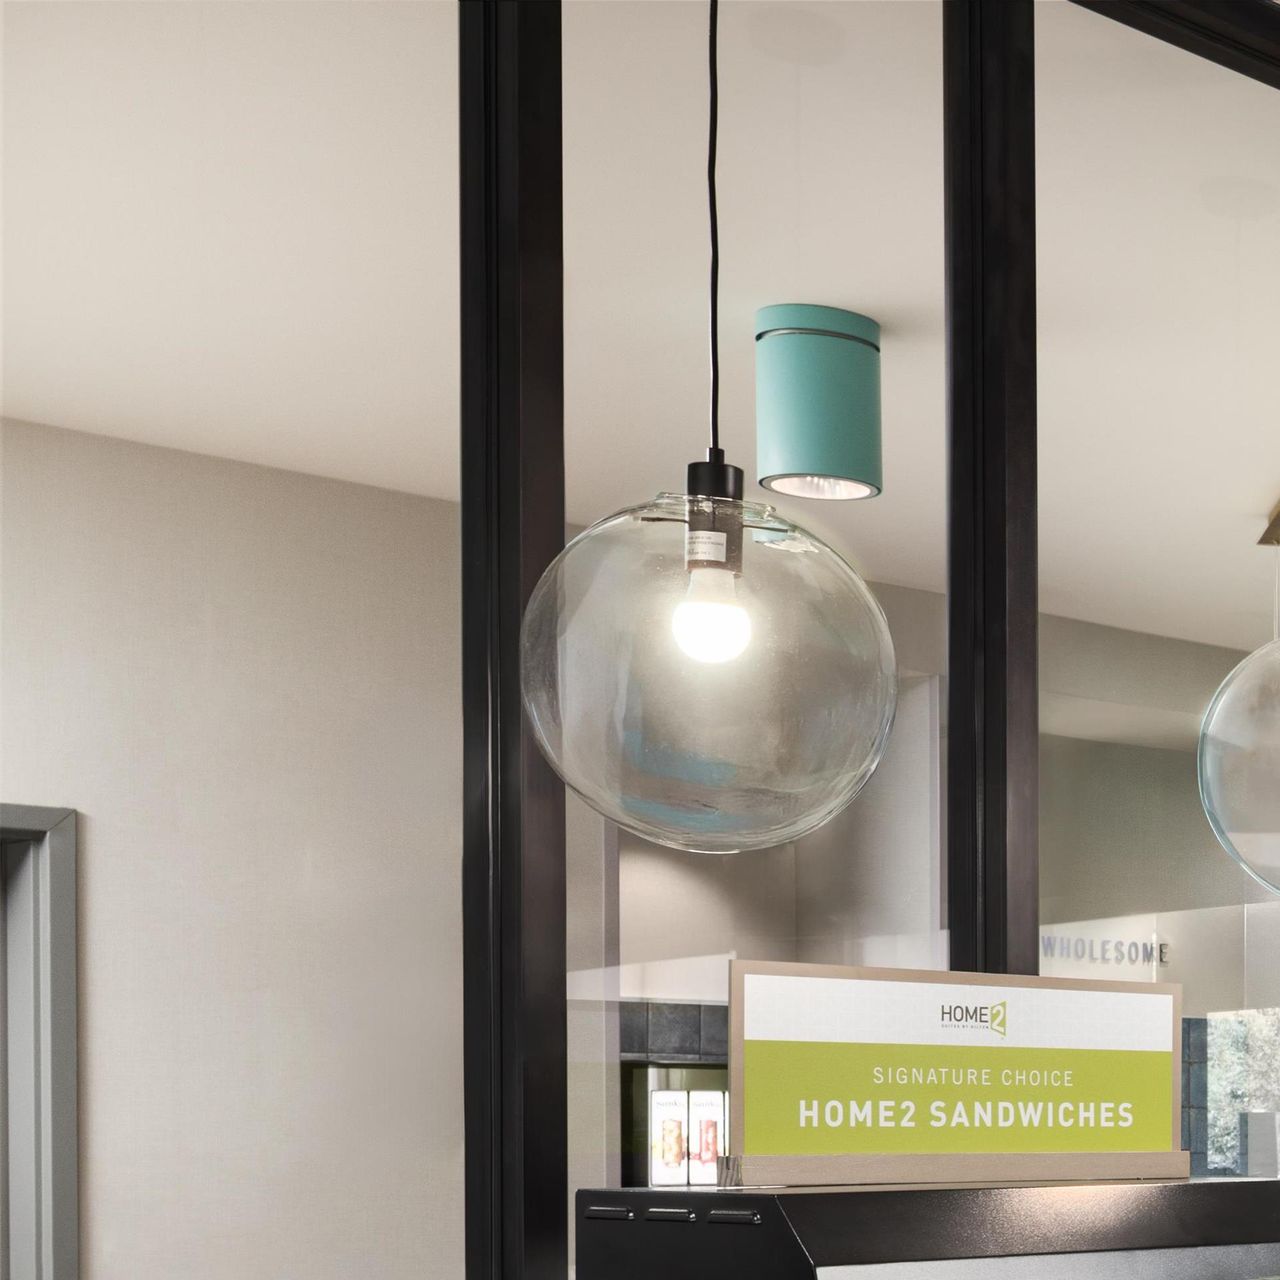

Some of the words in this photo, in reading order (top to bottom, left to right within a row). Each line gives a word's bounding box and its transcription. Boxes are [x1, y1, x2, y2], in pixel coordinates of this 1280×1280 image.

[1041, 936, 1169, 966] WHOLESOME
[872, 1066, 992, 1086] SIGNATURE
[1001, 1069, 1074, 1087] CHOICE
[799, 1099, 917, 1128] HOME2
[929, 1102, 1134, 1128] SANDWICHES
